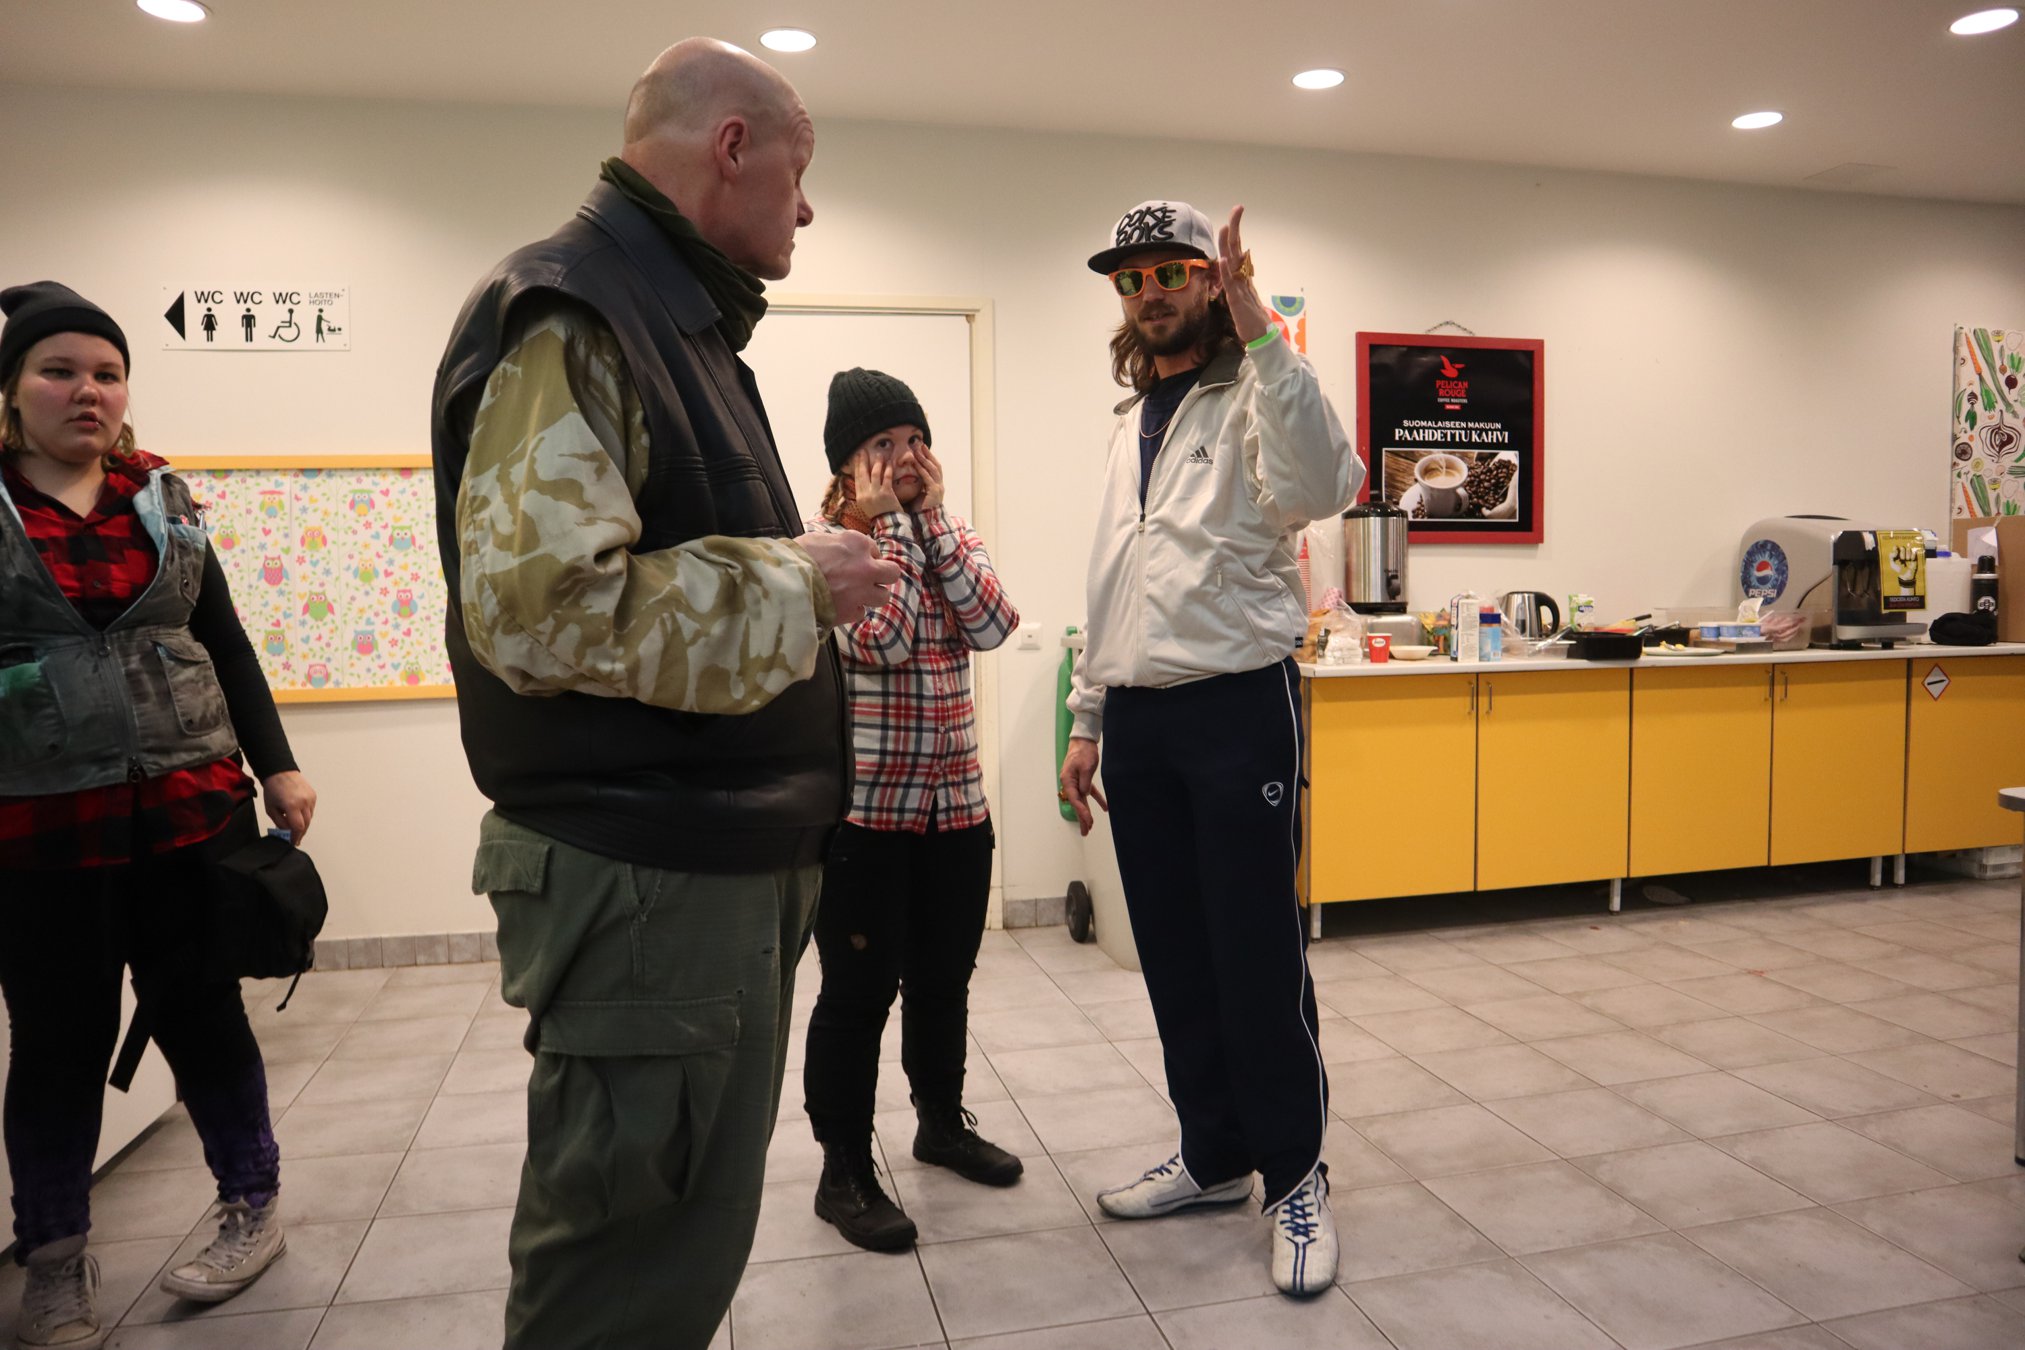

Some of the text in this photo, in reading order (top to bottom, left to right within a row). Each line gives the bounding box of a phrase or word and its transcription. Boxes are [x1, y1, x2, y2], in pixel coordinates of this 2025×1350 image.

[194, 290, 301, 305] WC WC WC
[1435, 380, 1468, 389] PELICAN
[1438, 389, 1467, 397] ROUGE
[1403, 420, 1502, 429] SUOMALAISEEN MAKUUN
[1395, 428, 1509, 444] PAAHDETTU KAHVI
[1186, 457, 1214, 465] adidas
[1748, 589, 1777, 598] PEPSI
